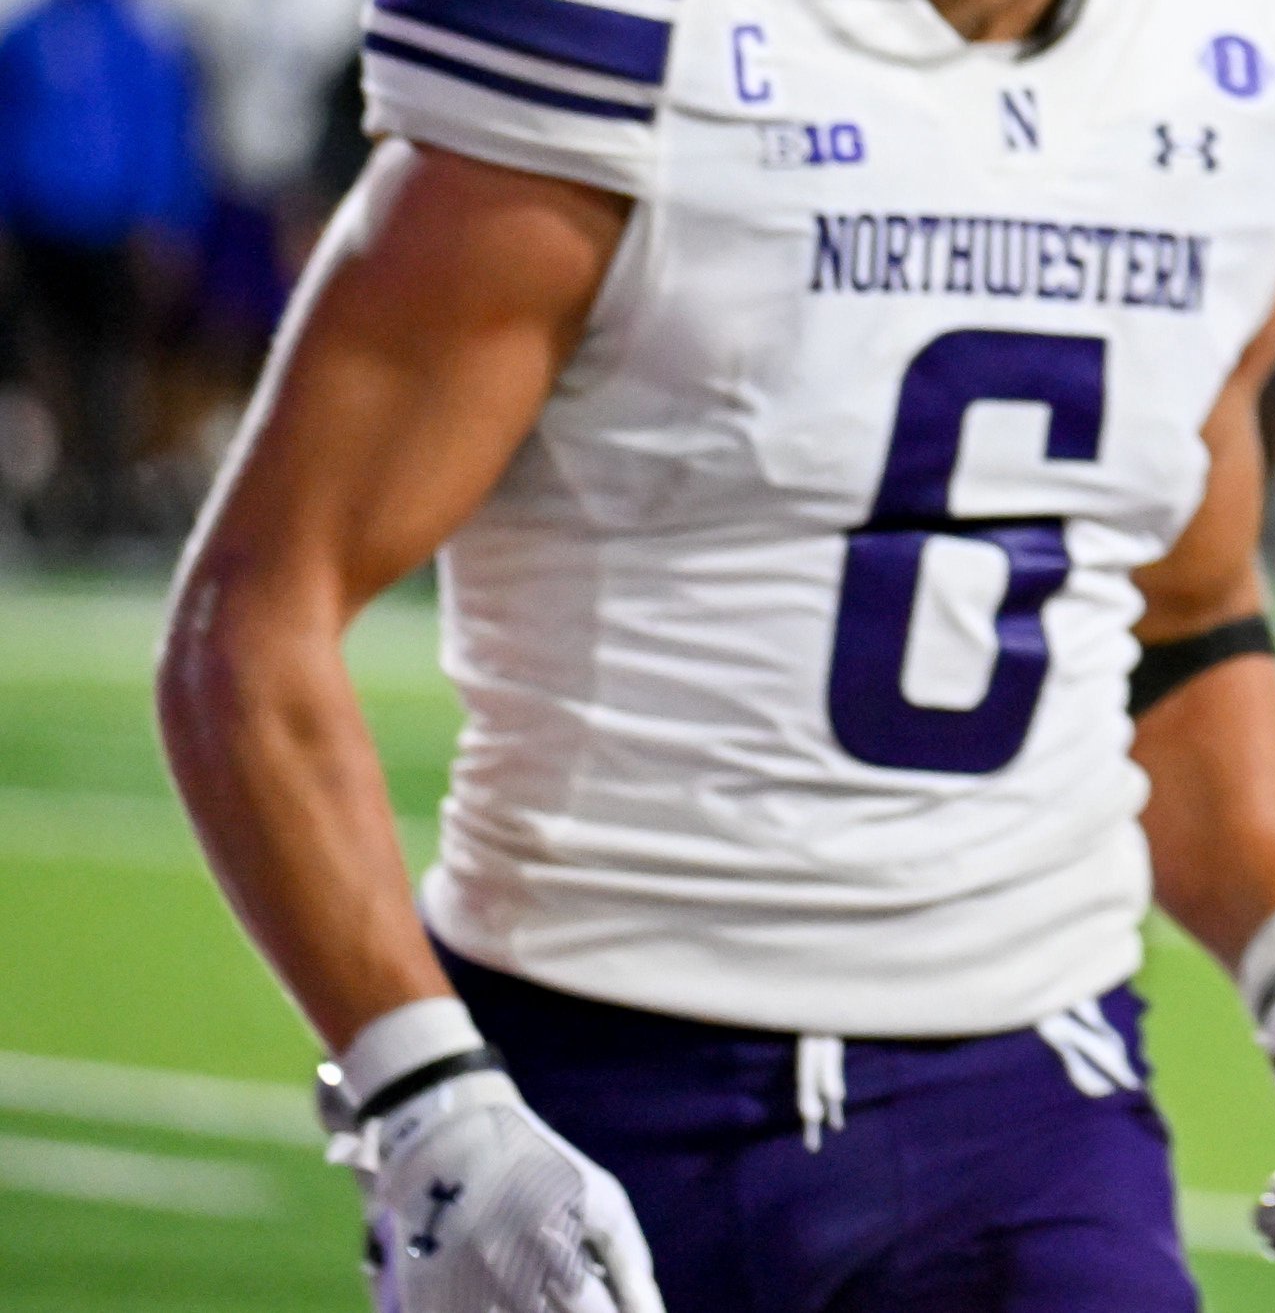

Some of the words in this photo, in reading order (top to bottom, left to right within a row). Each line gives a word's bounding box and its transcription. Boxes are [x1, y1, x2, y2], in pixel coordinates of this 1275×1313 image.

[732, 23, 772, 104] C
[810, 213, 1209, 312] NORTHWESTERN
[828, 328, 1108, 775] 6
